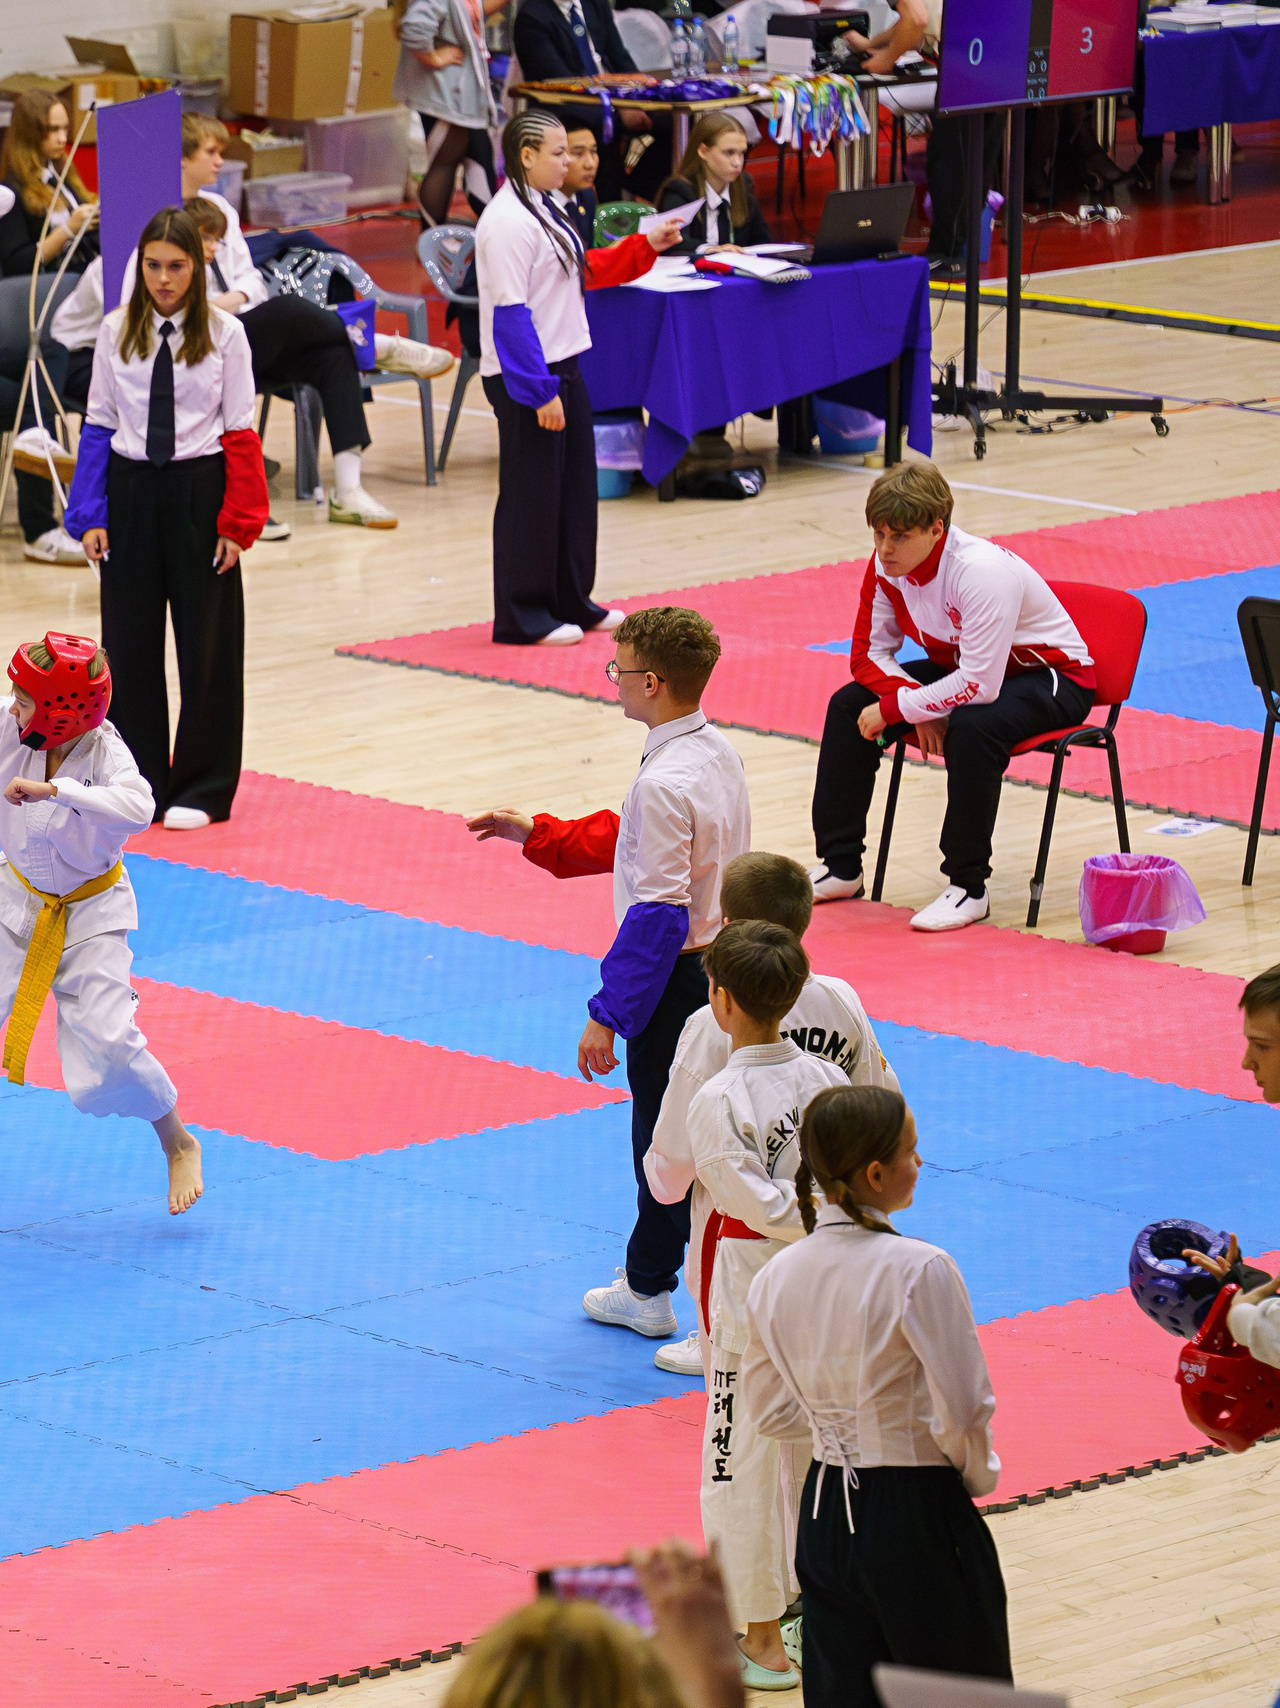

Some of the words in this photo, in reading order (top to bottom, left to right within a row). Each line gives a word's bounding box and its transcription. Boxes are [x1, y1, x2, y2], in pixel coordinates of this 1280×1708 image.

[969, 37, 983, 66] 0
[1080, 26, 1094, 54] 3
[1040, 59, 1048, 73] 0
[714, 1369, 738, 1388] ITF
